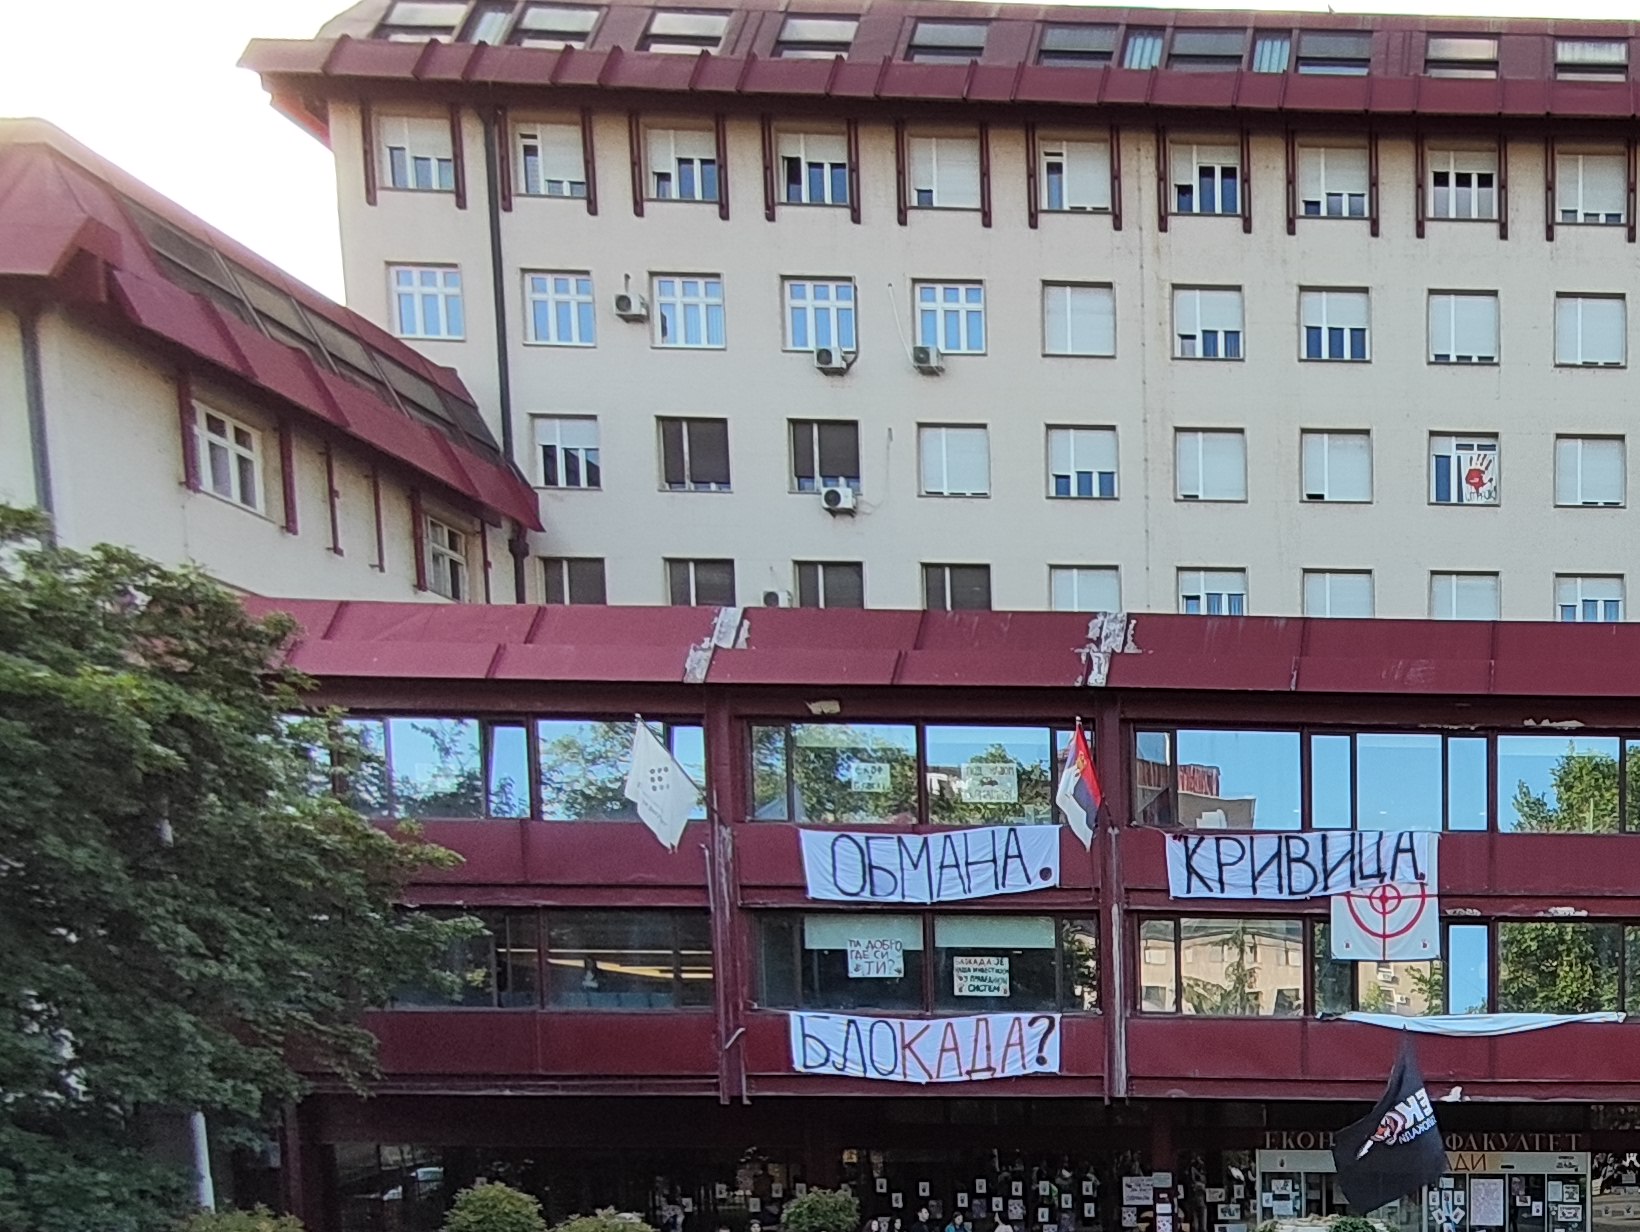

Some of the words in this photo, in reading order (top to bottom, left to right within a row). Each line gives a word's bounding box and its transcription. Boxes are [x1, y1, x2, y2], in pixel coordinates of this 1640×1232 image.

[831, 827, 1053, 897] ОБМАНА.
[850, 949, 869, 960] ГДЕ
[873, 950, 889, 960] СИ
[866, 939, 902, 952] ДОБРО
[864, 959, 895, 976] ТИ?
[797, 1013, 1056, 1080] БЛОКАДА?
[1445, 1132, 1582, 1152] ФАКУЛТЕТ
